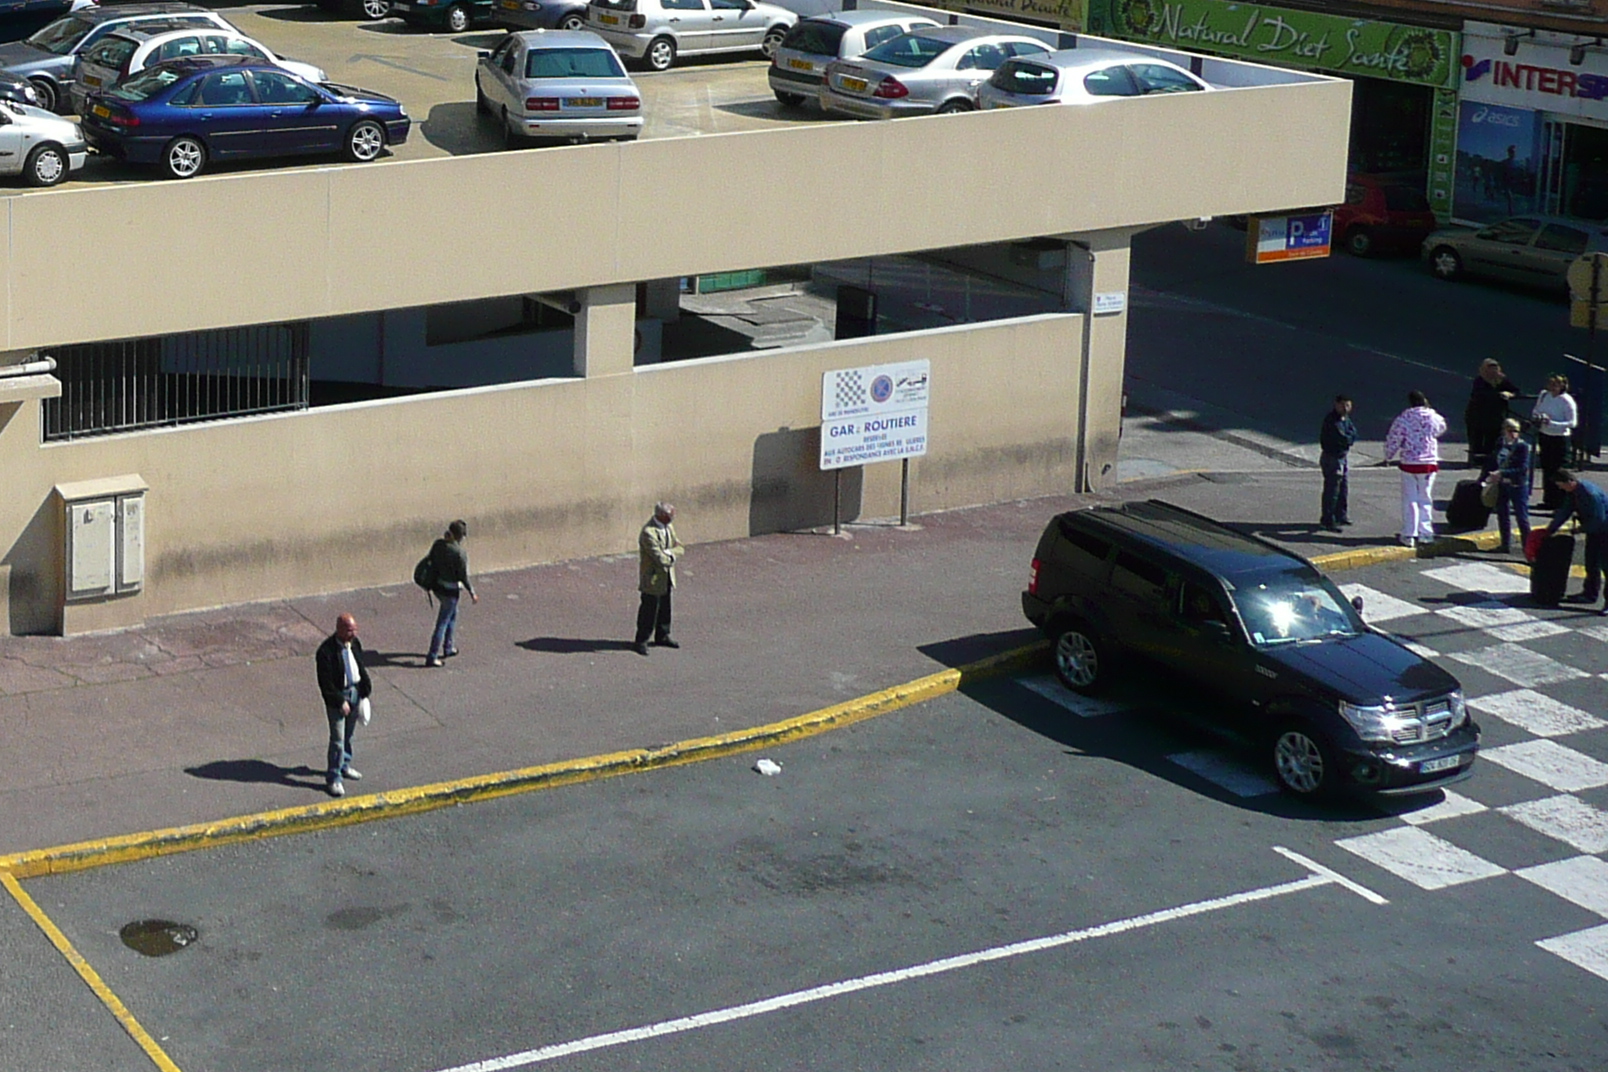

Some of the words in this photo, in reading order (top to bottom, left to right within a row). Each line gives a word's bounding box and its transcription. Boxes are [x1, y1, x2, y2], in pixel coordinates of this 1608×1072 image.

[1152, 3, 1261, 48] Natural
[1256, 15, 1332, 60] Diet
[1290, 220, 1304, 246] P
